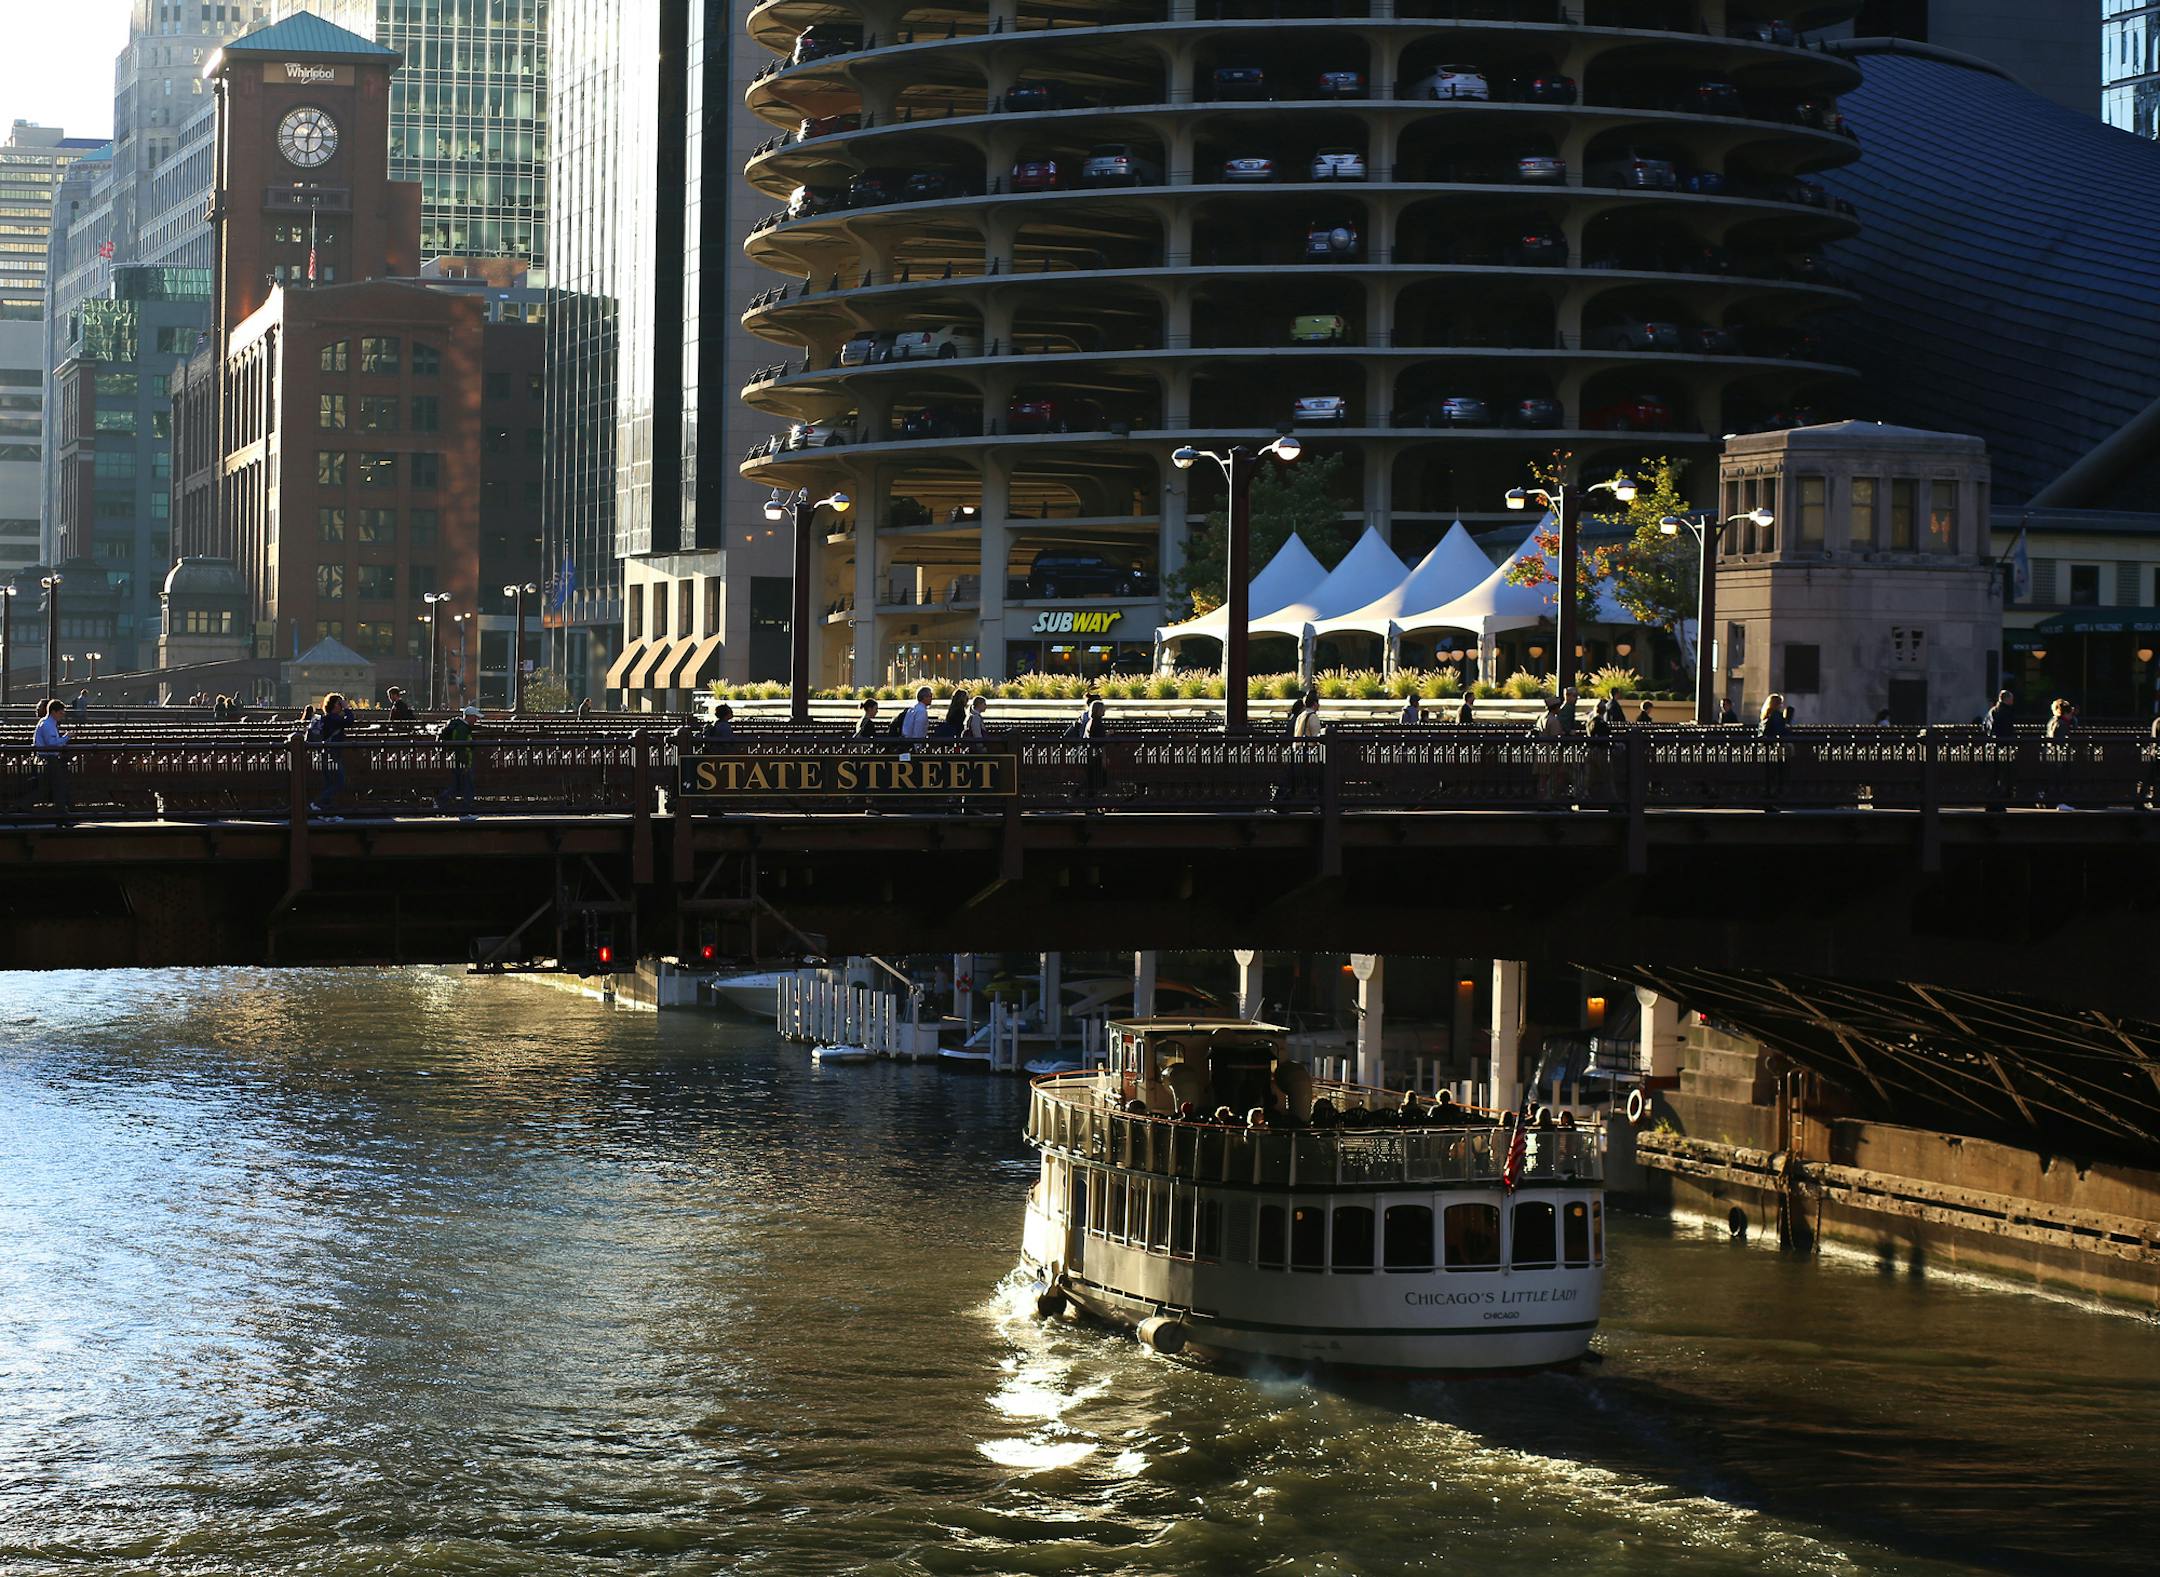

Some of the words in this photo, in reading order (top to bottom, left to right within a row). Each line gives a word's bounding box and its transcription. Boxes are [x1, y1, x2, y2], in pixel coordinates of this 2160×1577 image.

[285, 65, 335, 81] Whirlpool
[1032, 610, 1121, 633] SUBWAY
[696, 761, 823, 791] STATE
[837, 761, 999, 791] STREET
[1404, 1290, 1495, 1306] CHICAGO'S
[1501, 1290, 1548, 1304] LITTLE
[1551, 1287, 1578, 1302] LADY
[1483, 1311, 1520, 1320] CHICAGO
